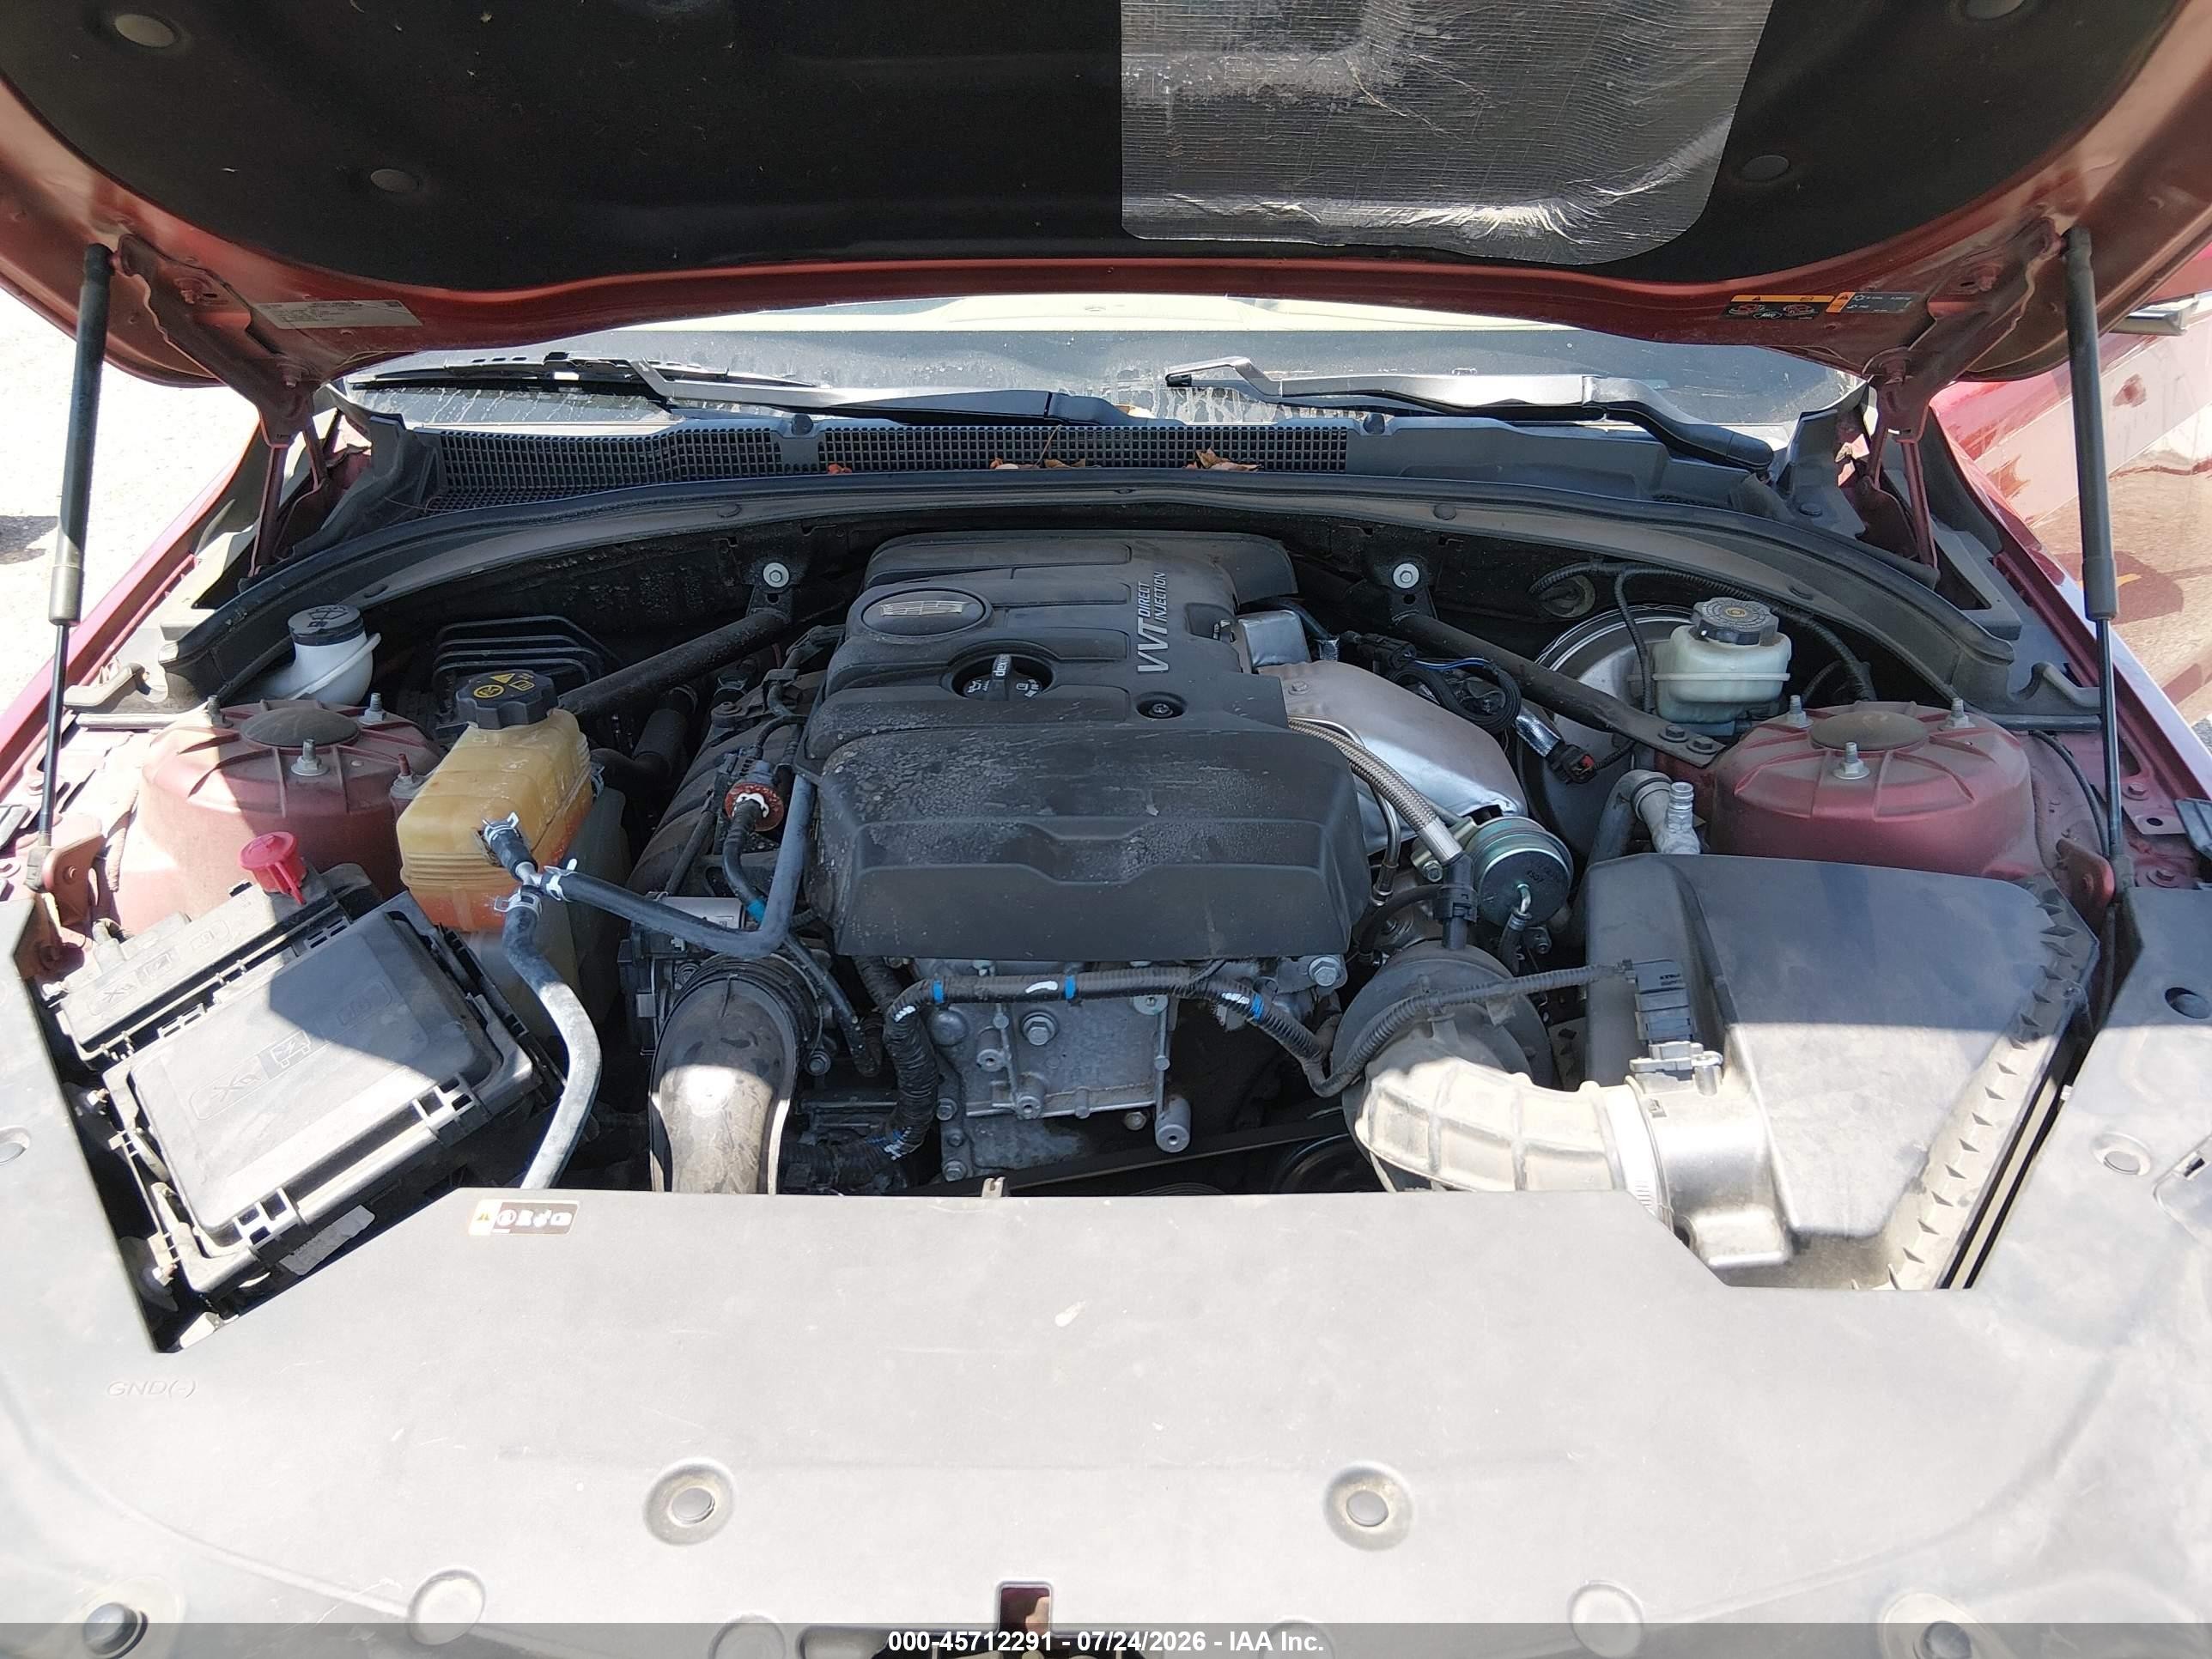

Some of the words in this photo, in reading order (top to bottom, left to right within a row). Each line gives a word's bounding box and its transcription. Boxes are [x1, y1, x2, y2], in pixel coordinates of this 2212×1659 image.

[1138, 580, 1151, 618] DIRECT
[1153, 571, 1167, 623] INJECTION
[1137, 617, 1169, 672] VVT
[107, 1379, 197, 1399] GND(-)
